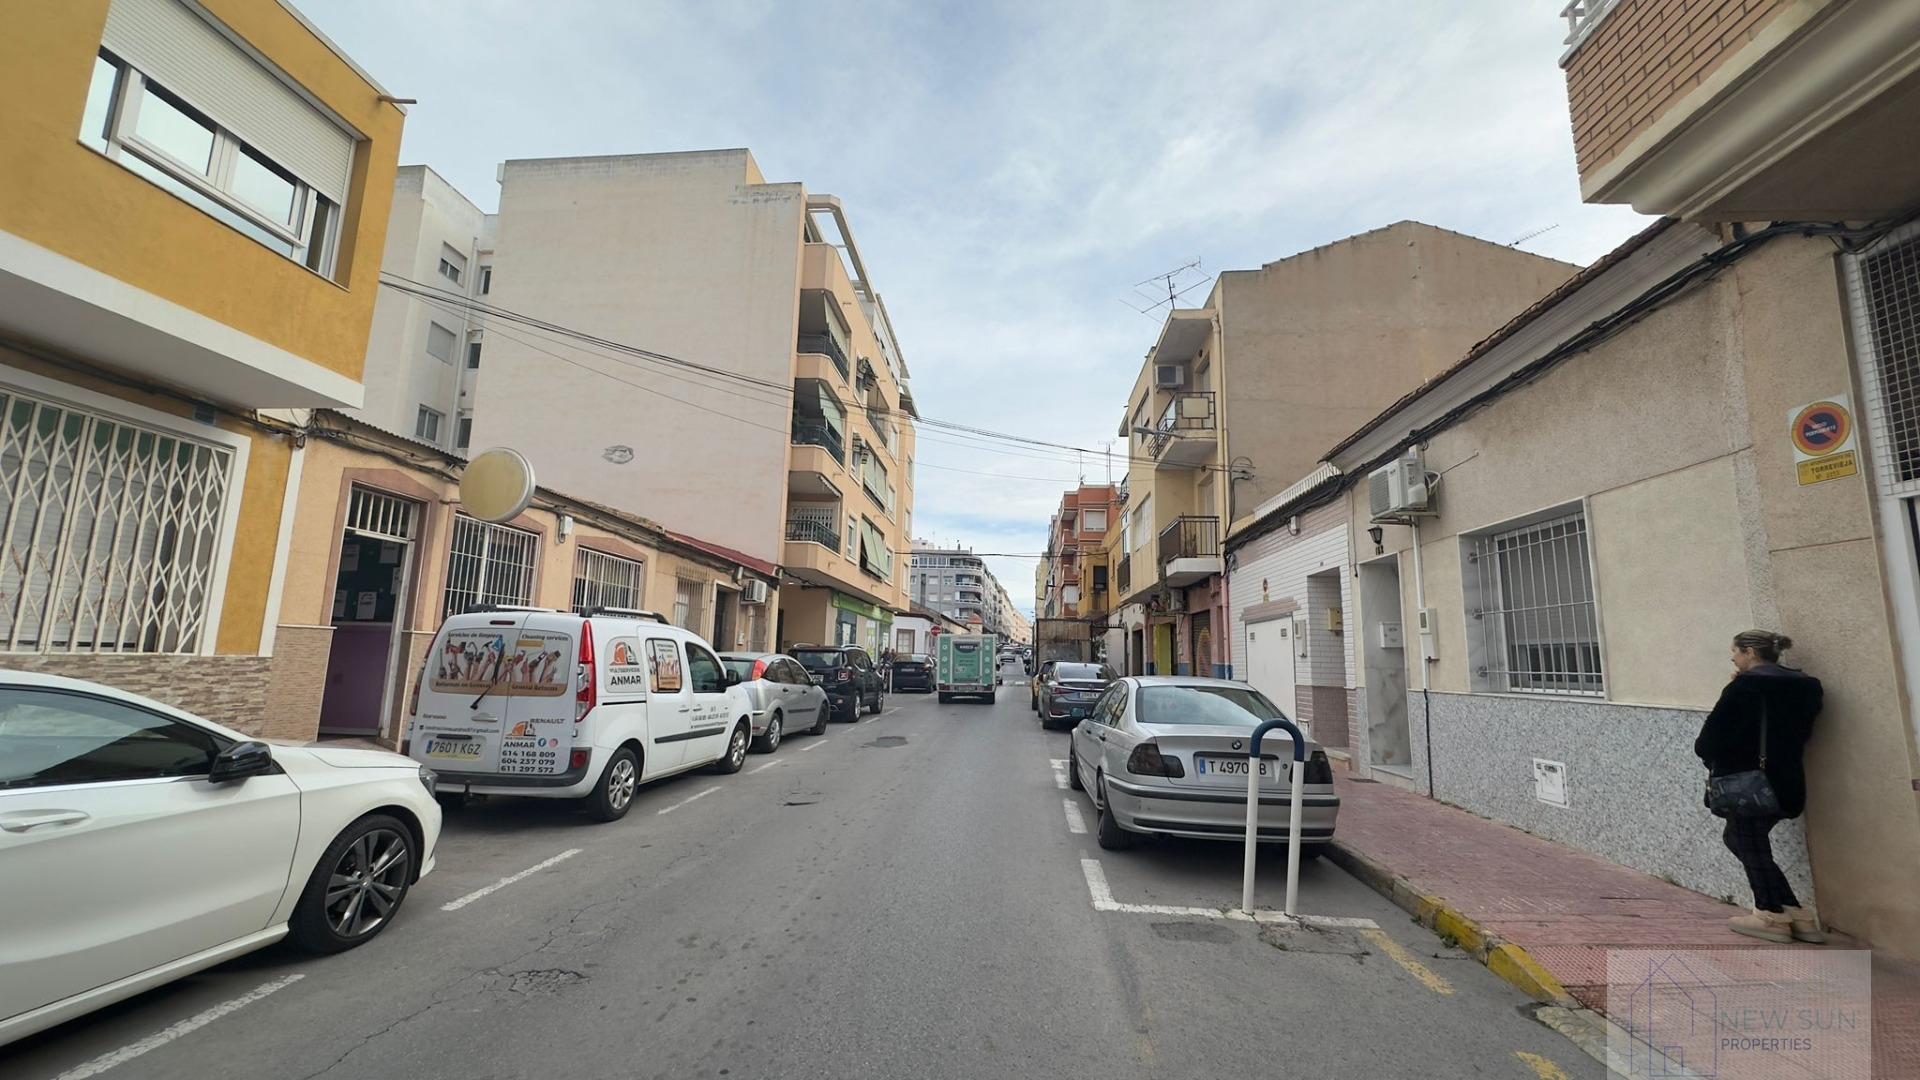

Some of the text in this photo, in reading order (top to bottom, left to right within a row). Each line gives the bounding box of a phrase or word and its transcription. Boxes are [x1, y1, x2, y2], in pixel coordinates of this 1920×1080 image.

[610, 675, 641, 686] ANMAR
[432, 741, 481, 755] 7601 KGZ
[1209, 761, 1216, 772] T
[1219, 761, 1249, 775] 4970
